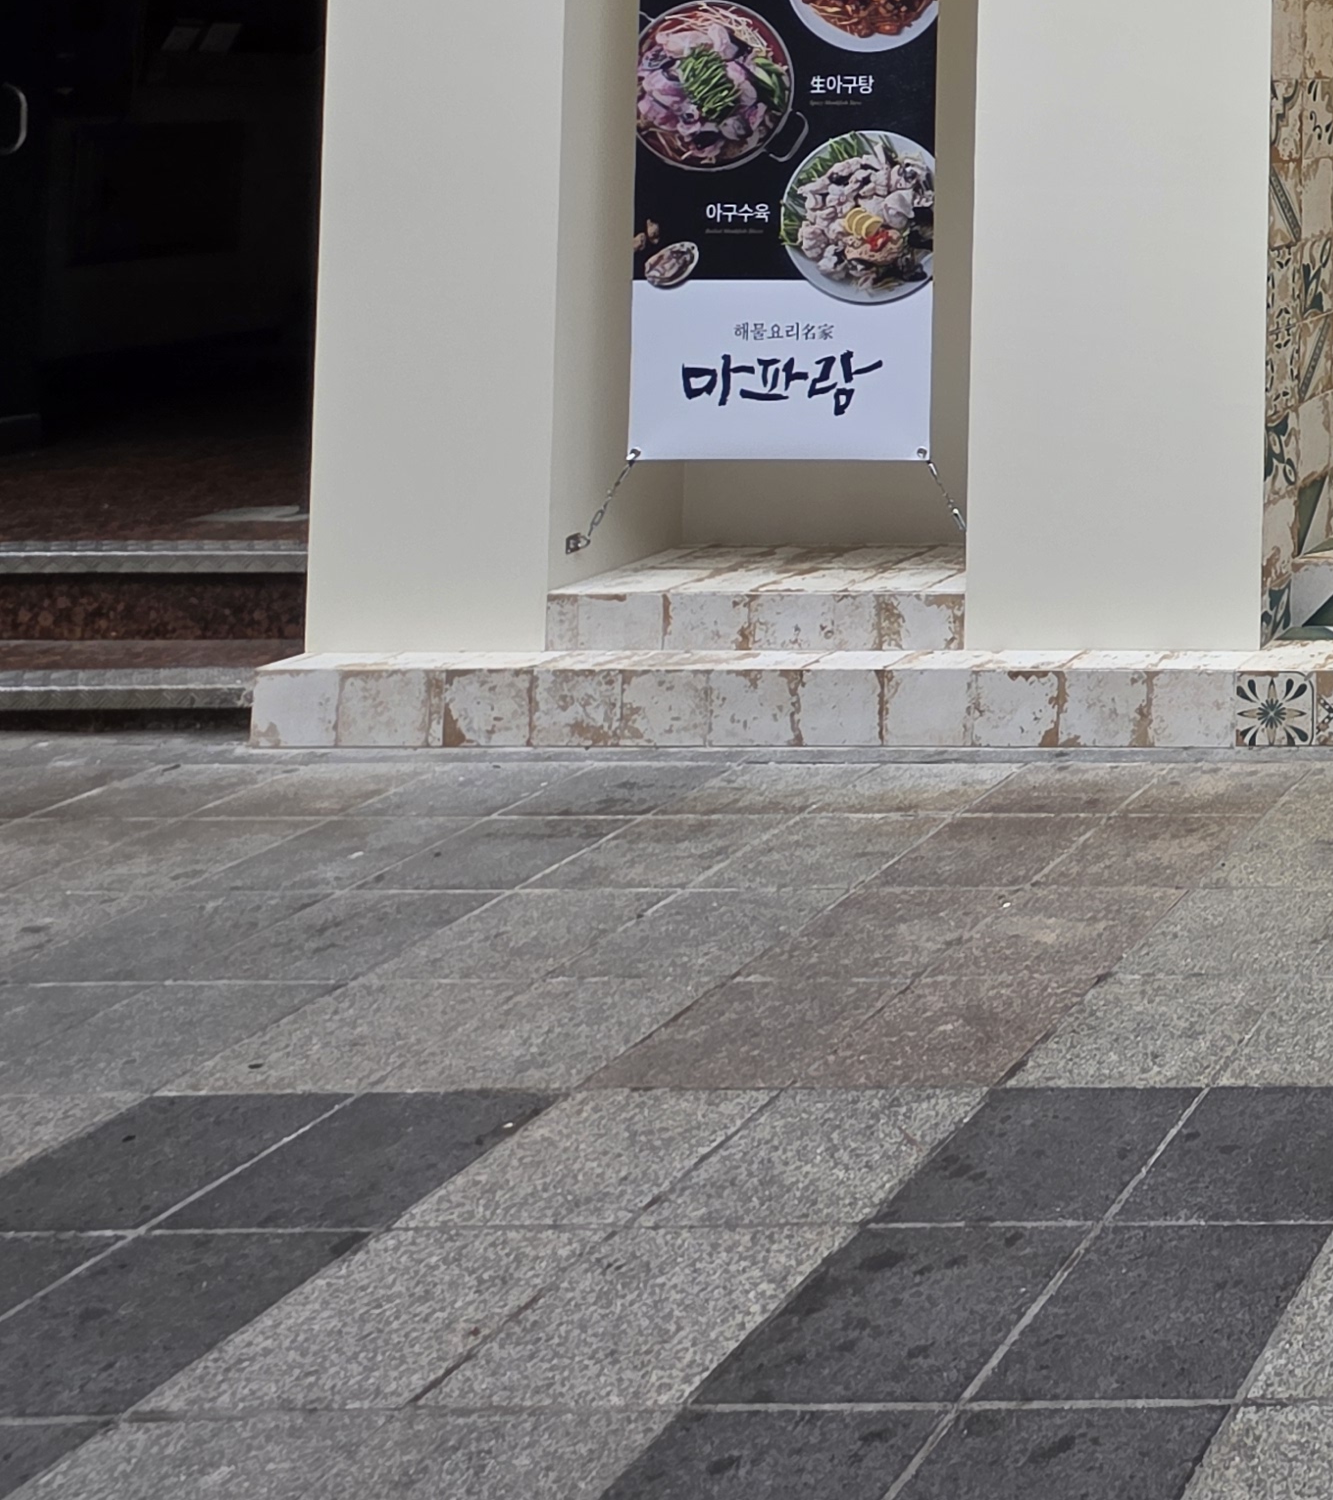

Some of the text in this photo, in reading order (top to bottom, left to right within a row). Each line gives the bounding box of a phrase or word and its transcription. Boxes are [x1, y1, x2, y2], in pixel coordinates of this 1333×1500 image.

[809, 74, 875, 94] 生아구탕
[705, 202, 771, 223] 아구수육
[734, 321, 834, 342] 해물요리名家
[681, 349, 884, 417] 마파람
